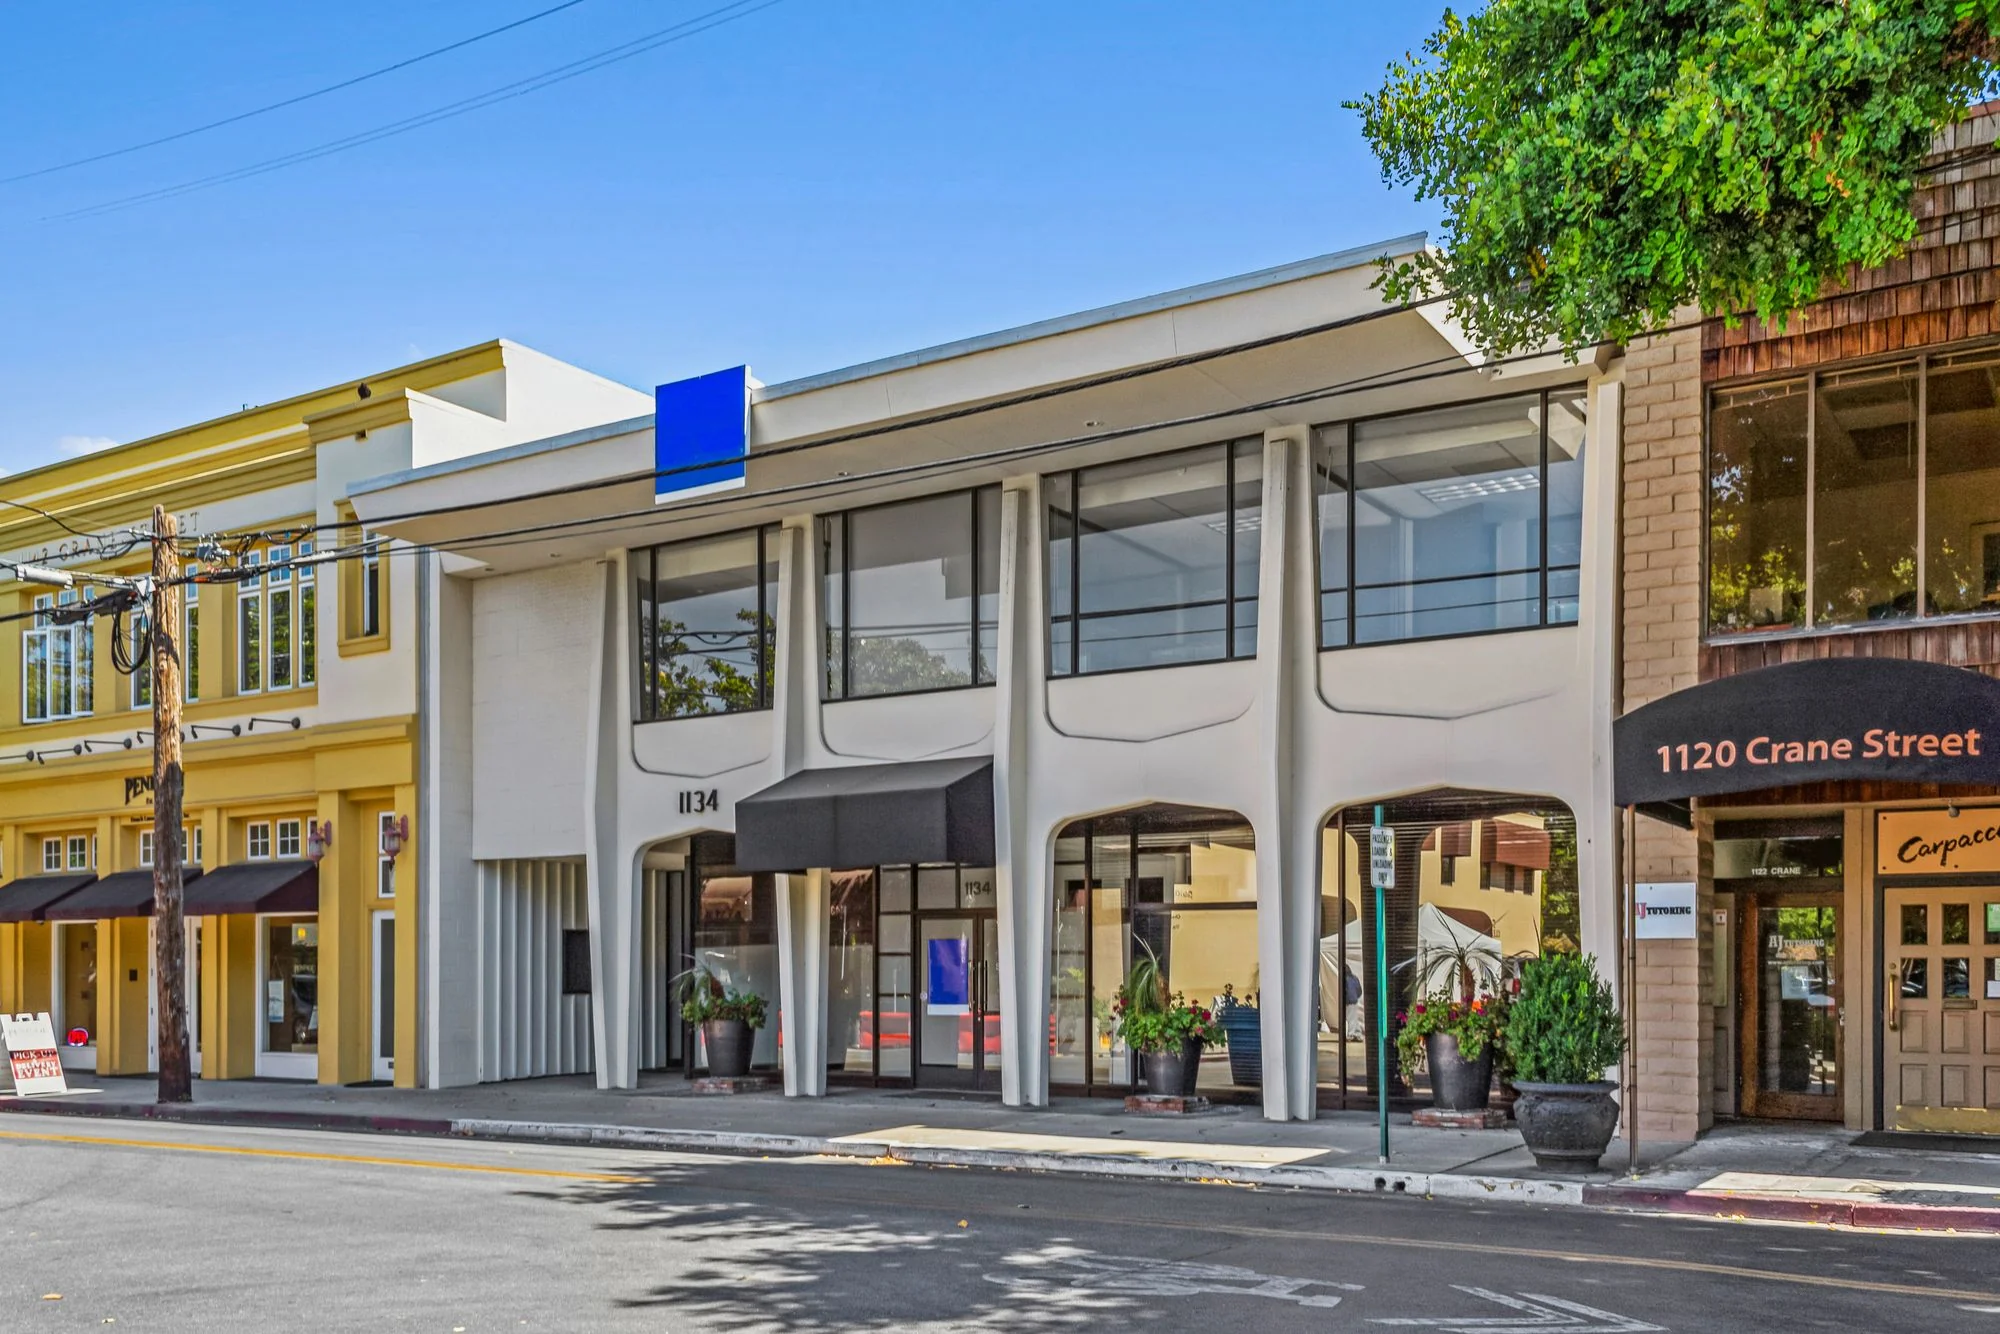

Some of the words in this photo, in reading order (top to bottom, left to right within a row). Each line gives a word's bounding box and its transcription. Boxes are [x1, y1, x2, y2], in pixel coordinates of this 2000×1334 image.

[1657, 740, 1736, 773] 1120
[1745, 736, 1853, 765] Crane
[1862, 728, 1981, 758] Street
[679, 788, 719, 814] 1134
[1372, 846, 1388, 857] LOADING
[1751, 867, 1768, 875] 1122
[1770, 866, 1801, 875] CRANE
[965, 881, 991, 895] 1134
[1646, 906, 1691, 915] TUTORING
[18, 1066, 57, 1079] EVENT
